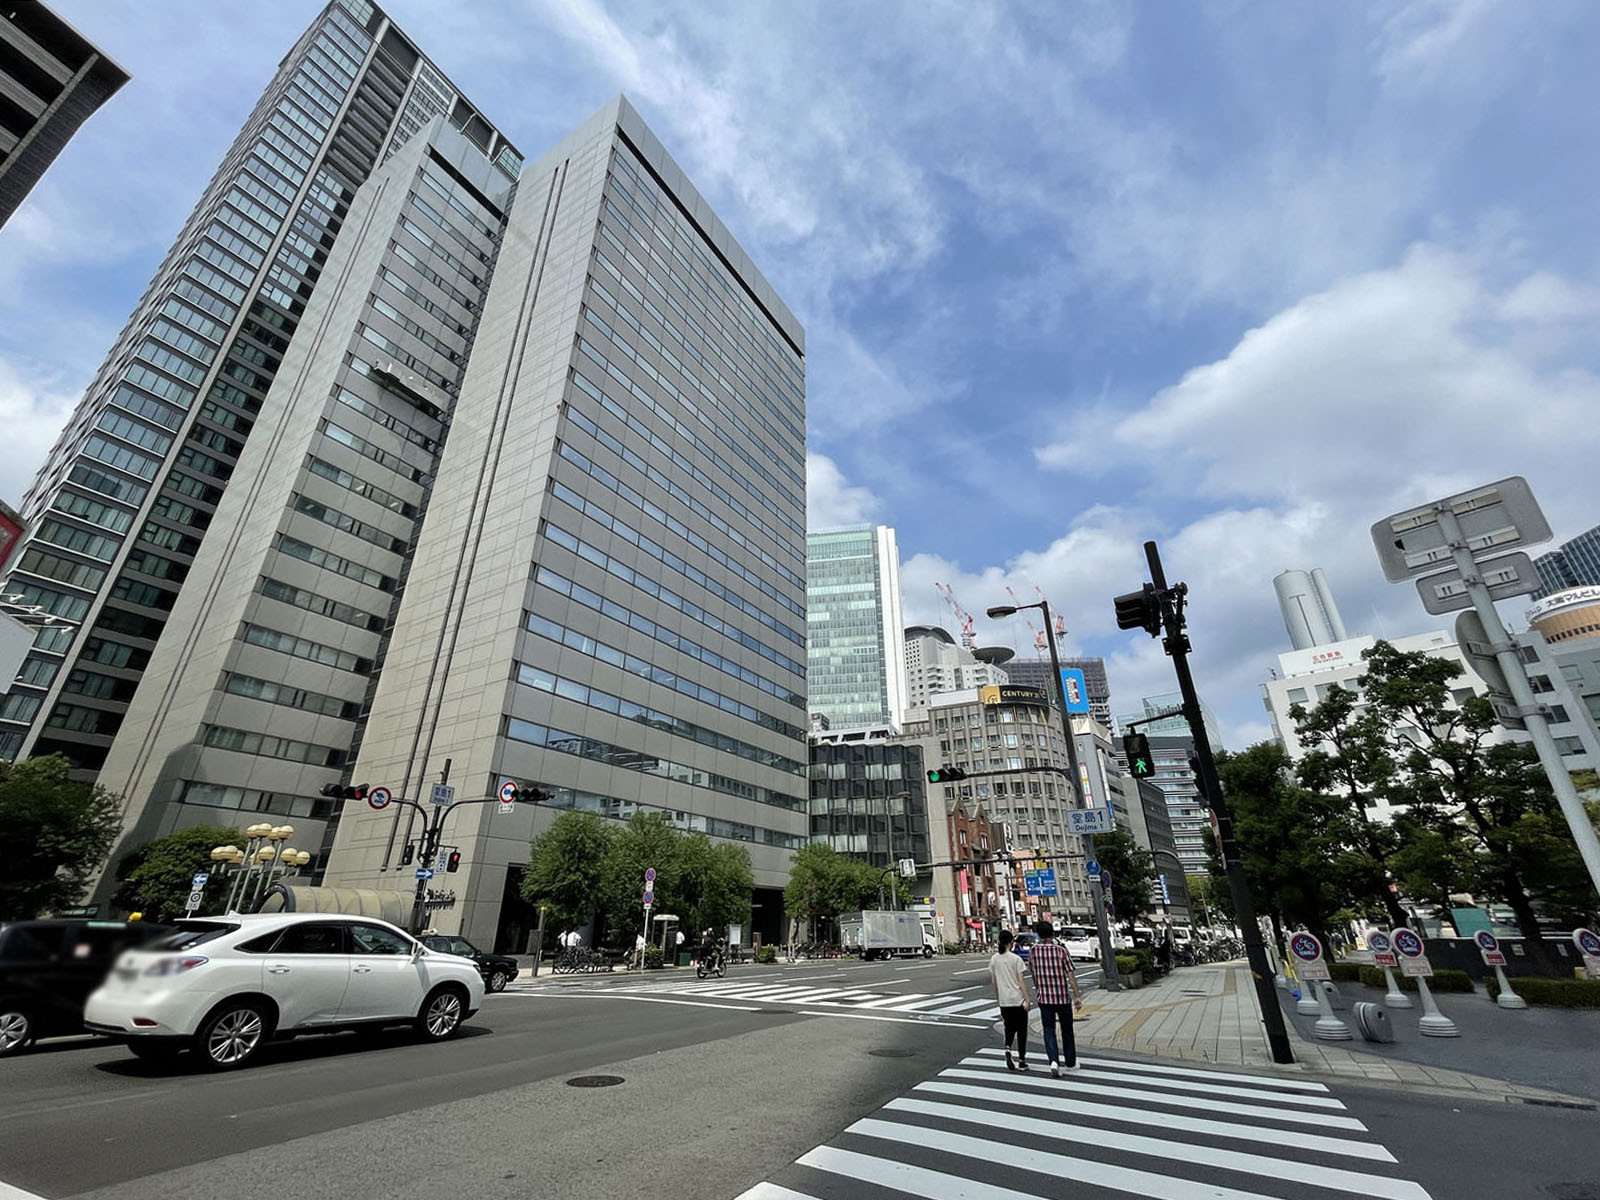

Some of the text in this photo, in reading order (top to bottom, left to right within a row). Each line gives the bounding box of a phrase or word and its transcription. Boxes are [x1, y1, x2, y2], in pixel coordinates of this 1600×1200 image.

[1002, 690, 1033, 698] CENTURY
[1072, 810, 1103, 824] 堂島1
[1075, 824, 1098, 832] Dojima
